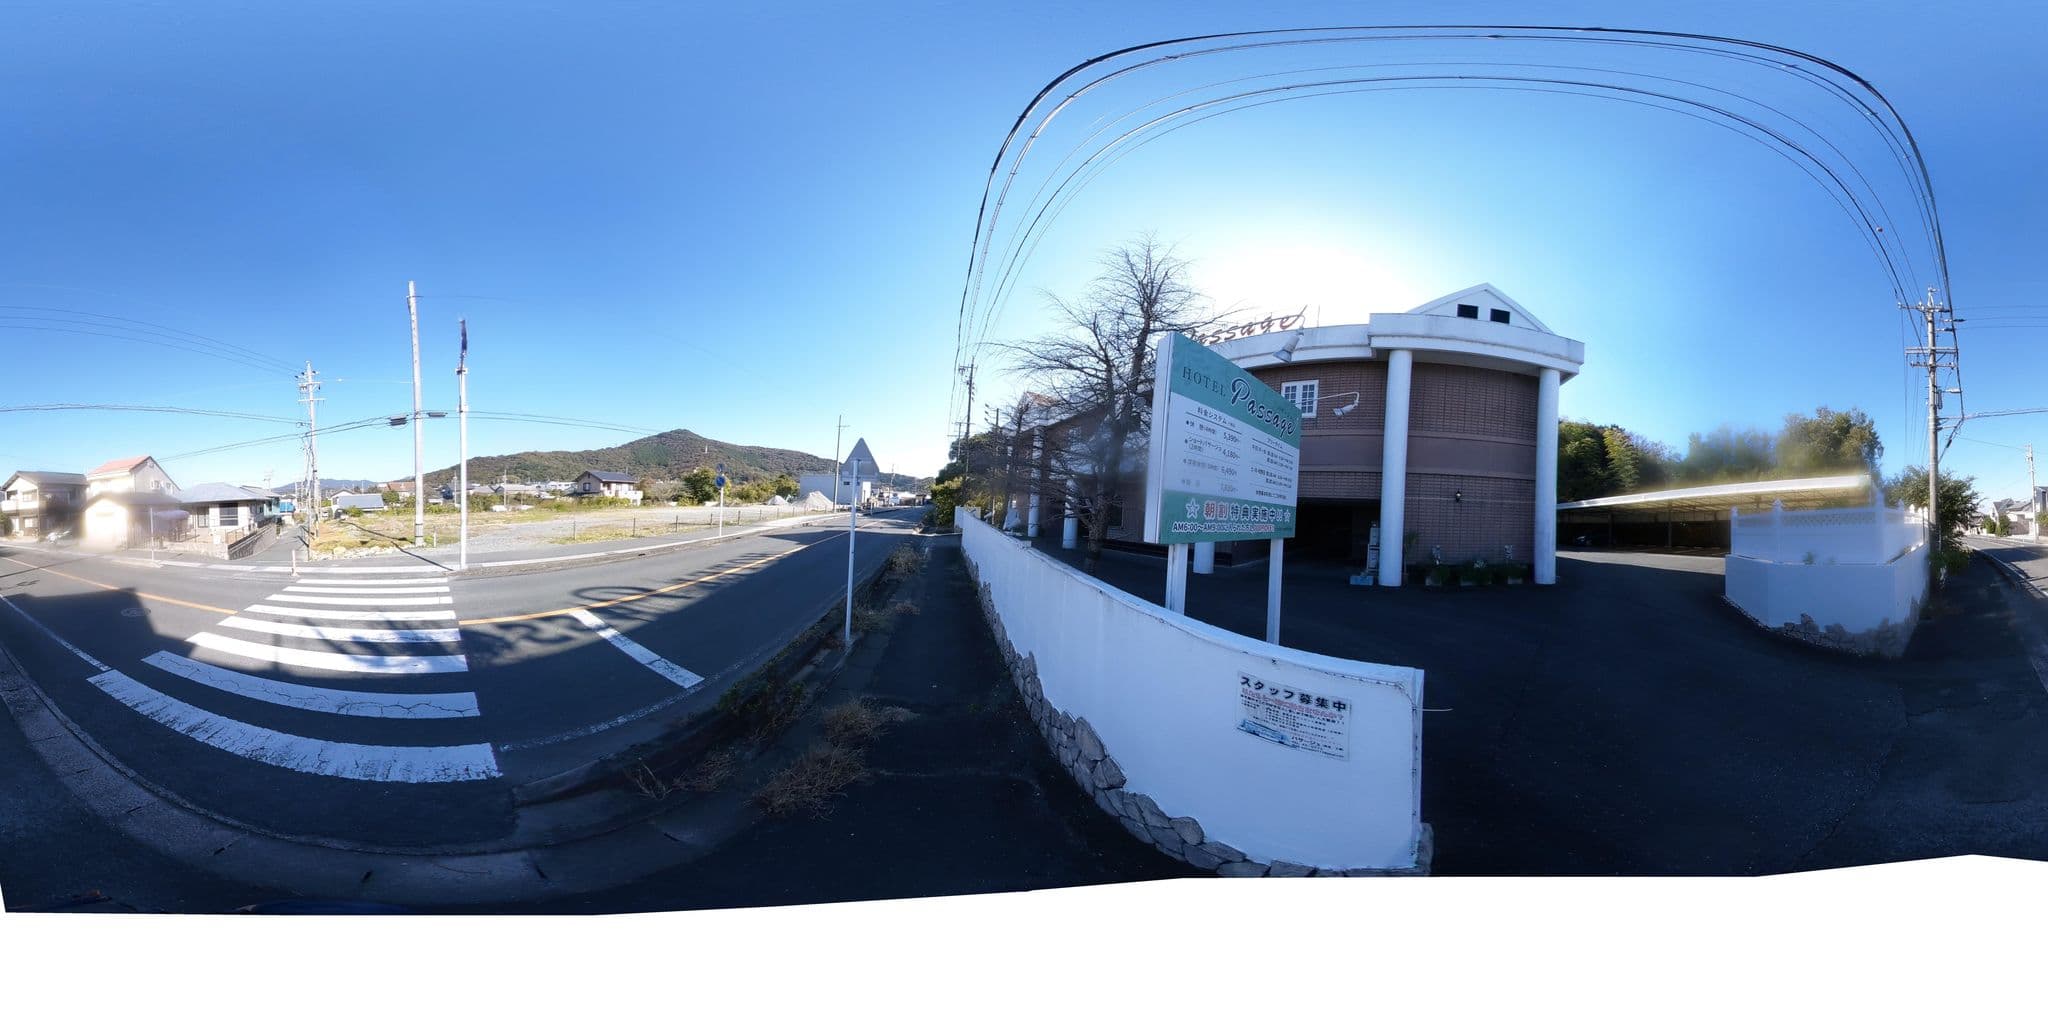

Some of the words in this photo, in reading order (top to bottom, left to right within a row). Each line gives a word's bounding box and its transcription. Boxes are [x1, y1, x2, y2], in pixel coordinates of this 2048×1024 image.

[1186, 305, 1307, 346] assage
[1181, 365, 1227, 397] HOTEL
[1231, 377, 1296, 437] Passage
[1240, 676, 1347, 712] スタッフ募集中
